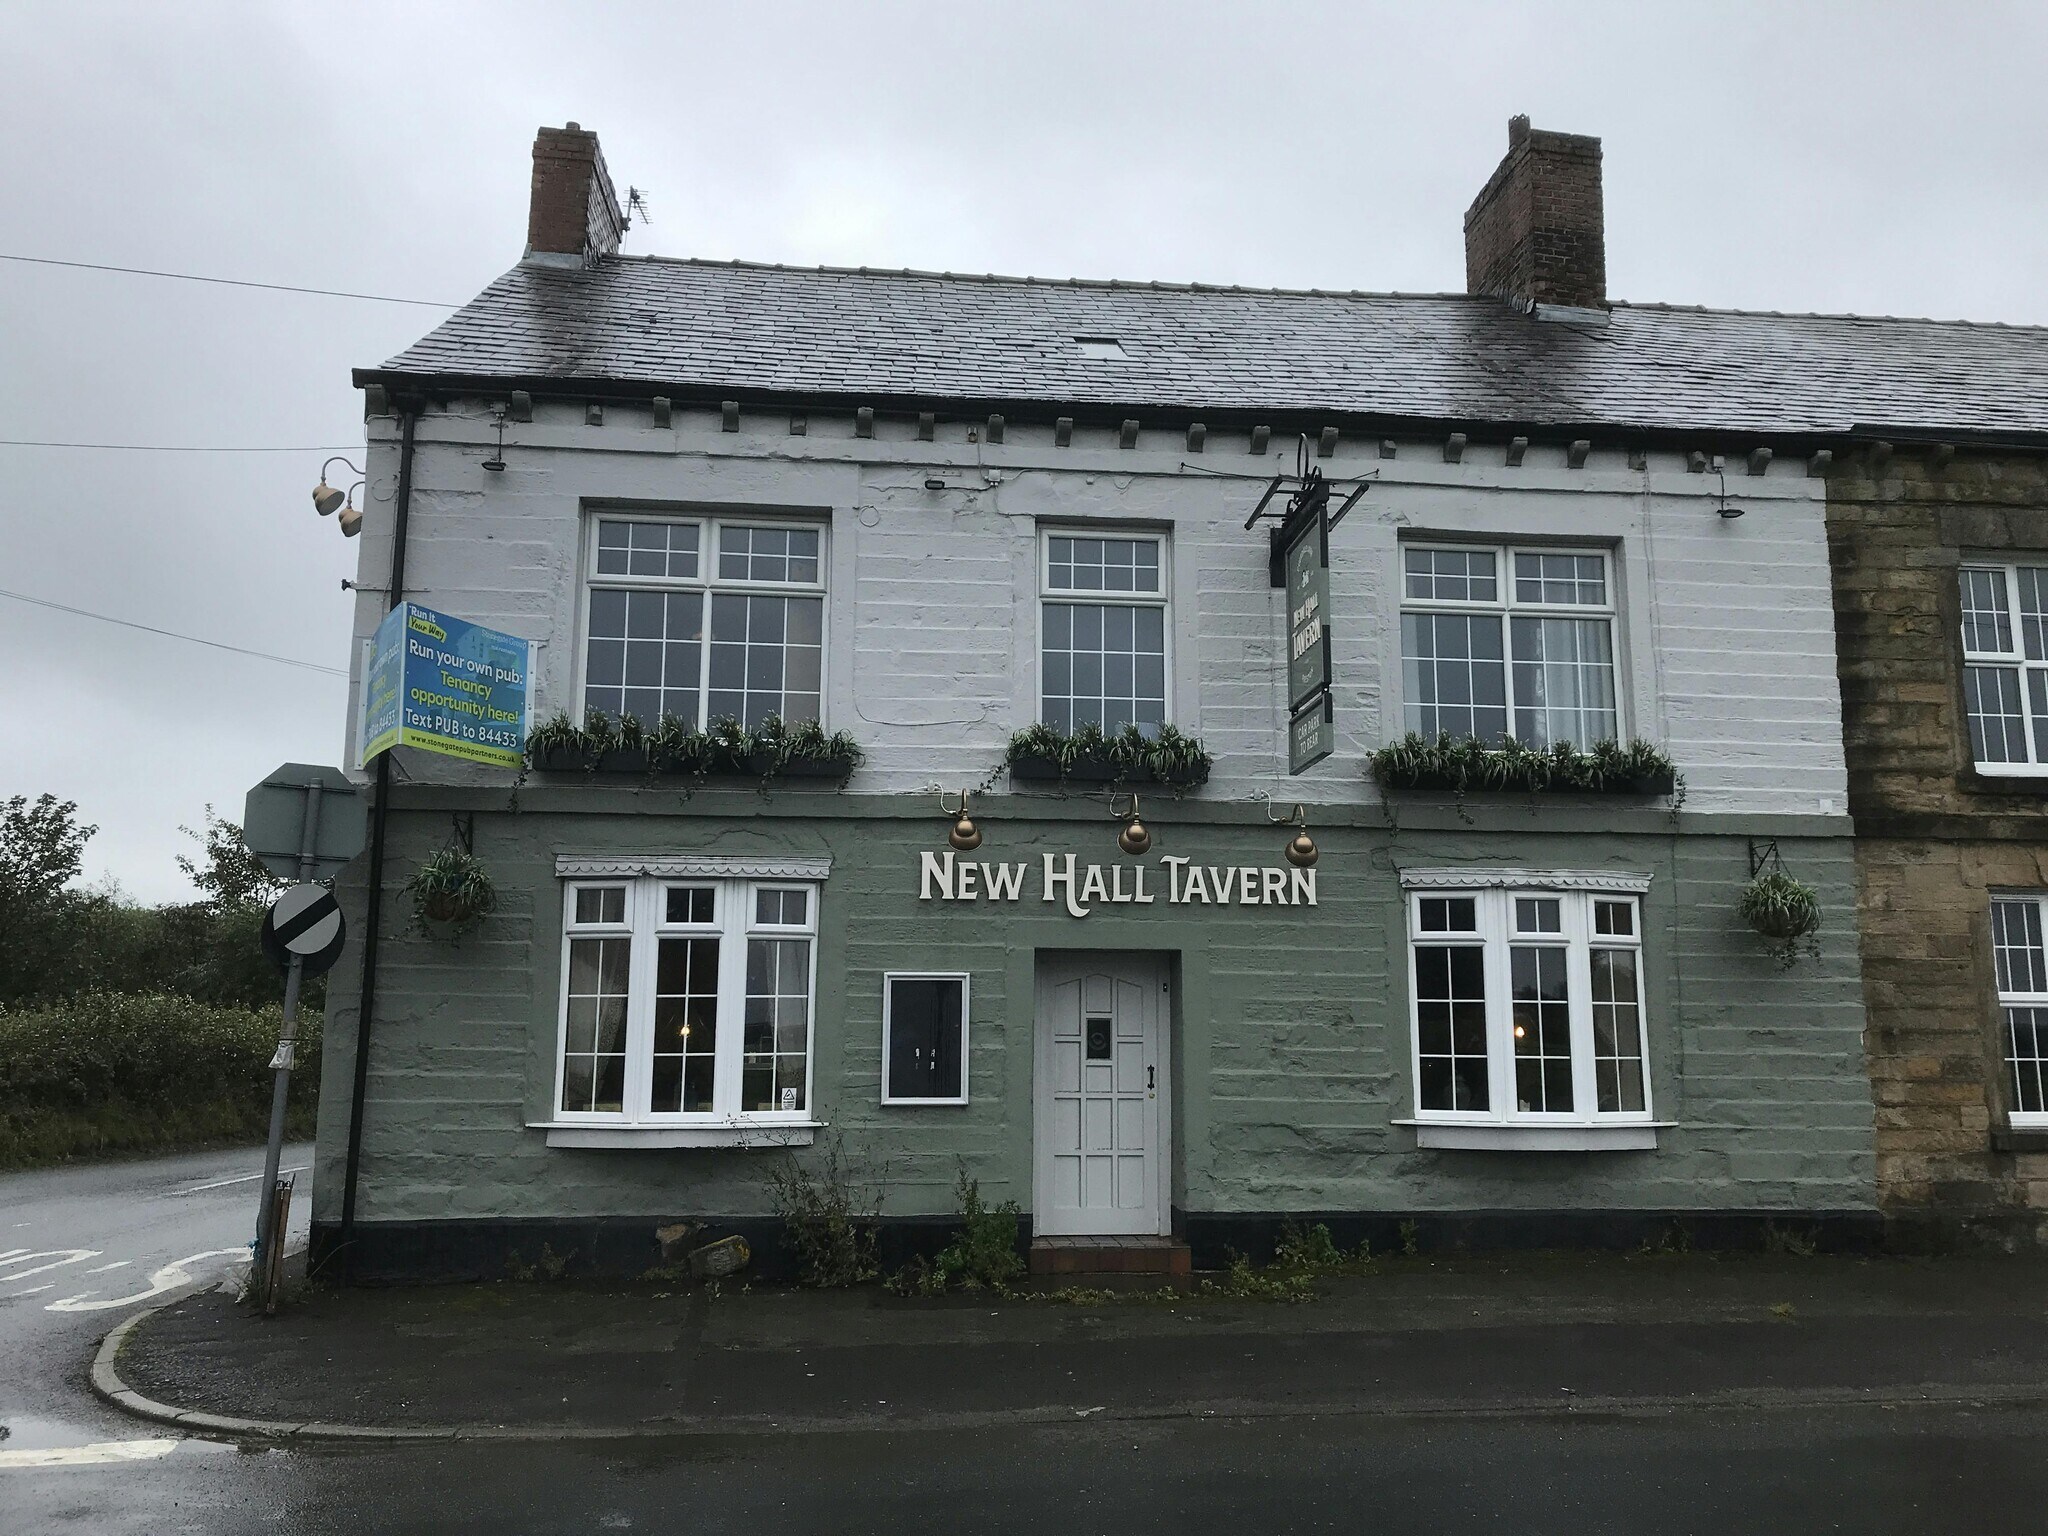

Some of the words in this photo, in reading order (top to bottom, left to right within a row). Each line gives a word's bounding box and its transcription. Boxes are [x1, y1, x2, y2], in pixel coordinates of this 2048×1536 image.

[411, 605, 428, 620] Run
[429, 612, 436, 623] It
[1294, 604, 1305, 628] NEW
[411, 617, 427, 631] Your
[429, 625, 444, 640] Way
[1292, 615, 1321, 660] TAVERN
[410, 639, 434, 660] Run
[436, 650, 464, 669] your
[467, 660, 493, 677] own
[495, 668, 523, 685] pub:
[441, 670, 492, 700] Tenancy
[411, 688, 485, 720] opportunity
[488, 704, 518, 724] here!
[405, 708, 432, 729] Text
[435, 716, 459, 735] PUB
[462, 723, 475, 738] to
[478, 726, 517, 748] 84433
[1298, 723, 1307, 740] CAR
[1308, 714, 1320, 734] PARK
[411, 735, 515, 762] www.stonegatepubpartners.co.uk
[1300, 741, 1307, 755] TO
[1307, 732, 1319, 751] REAR
[919, 851, 1028, 900] NEW
[1042, 853, 1155, 917] HALL
[1160, 855, 1318, 906] TAVERN
